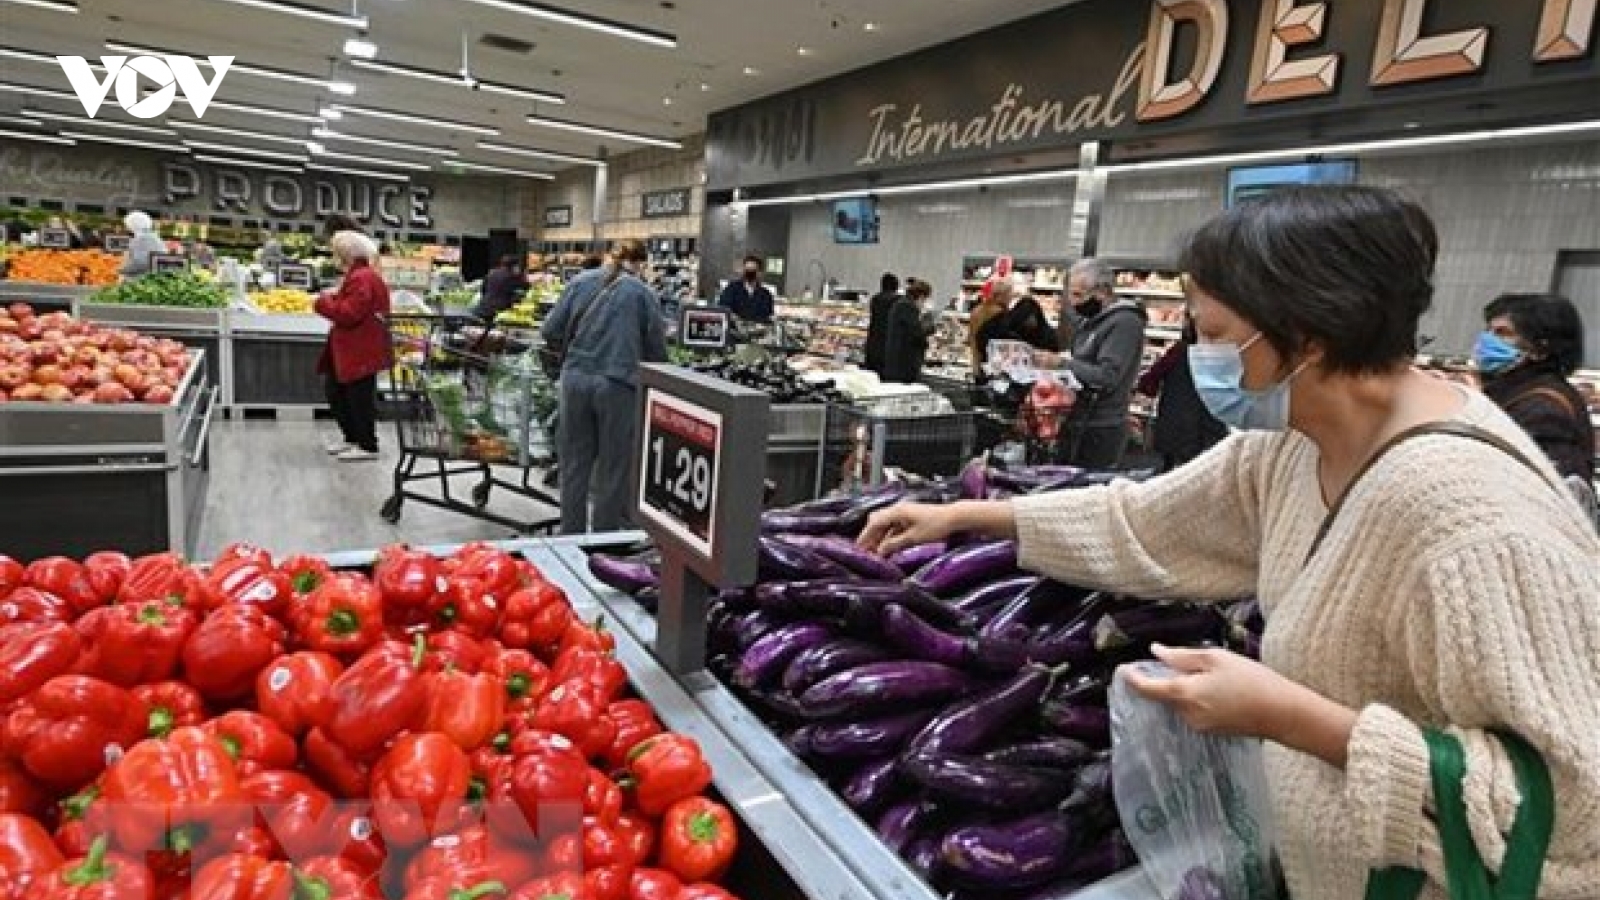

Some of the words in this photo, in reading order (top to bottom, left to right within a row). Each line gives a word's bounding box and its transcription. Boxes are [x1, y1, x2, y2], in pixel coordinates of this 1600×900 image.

[854, 40, 1149, 166] International
[164, 164, 432, 227] PRODUCE
[652, 436, 711, 511] 1.29
